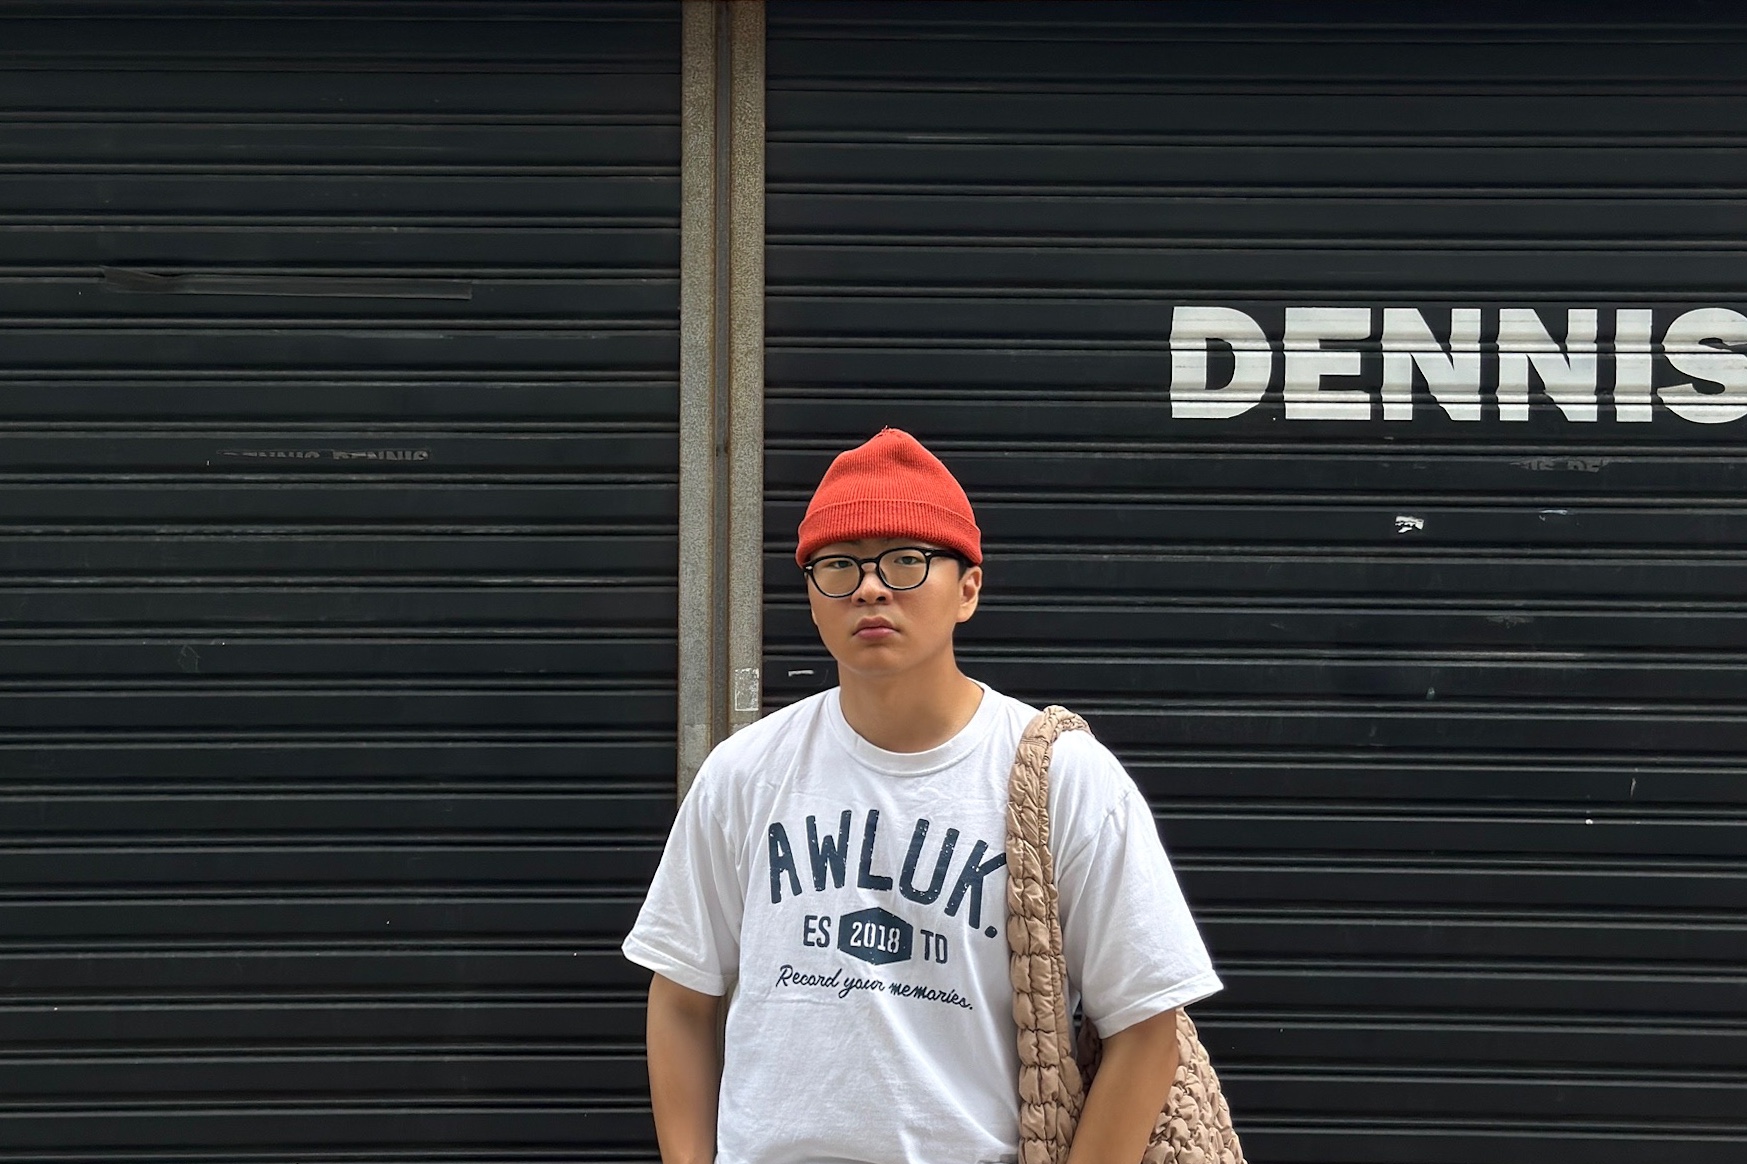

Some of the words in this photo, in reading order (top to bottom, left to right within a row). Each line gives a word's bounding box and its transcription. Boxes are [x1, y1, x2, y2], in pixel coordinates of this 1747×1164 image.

[1169, 306, 1747, 424] DENNIS
[767, 809, 1007, 939] AWLUK.
[802, 914, 831, 948] ES
[850, 921, 901, 954] 2018
[920, 929, 948, 965] TD
[775, 964, 843, 988] Record
[838, 976, 886, 999] your
[889, 982, 974, 1010] memories.
